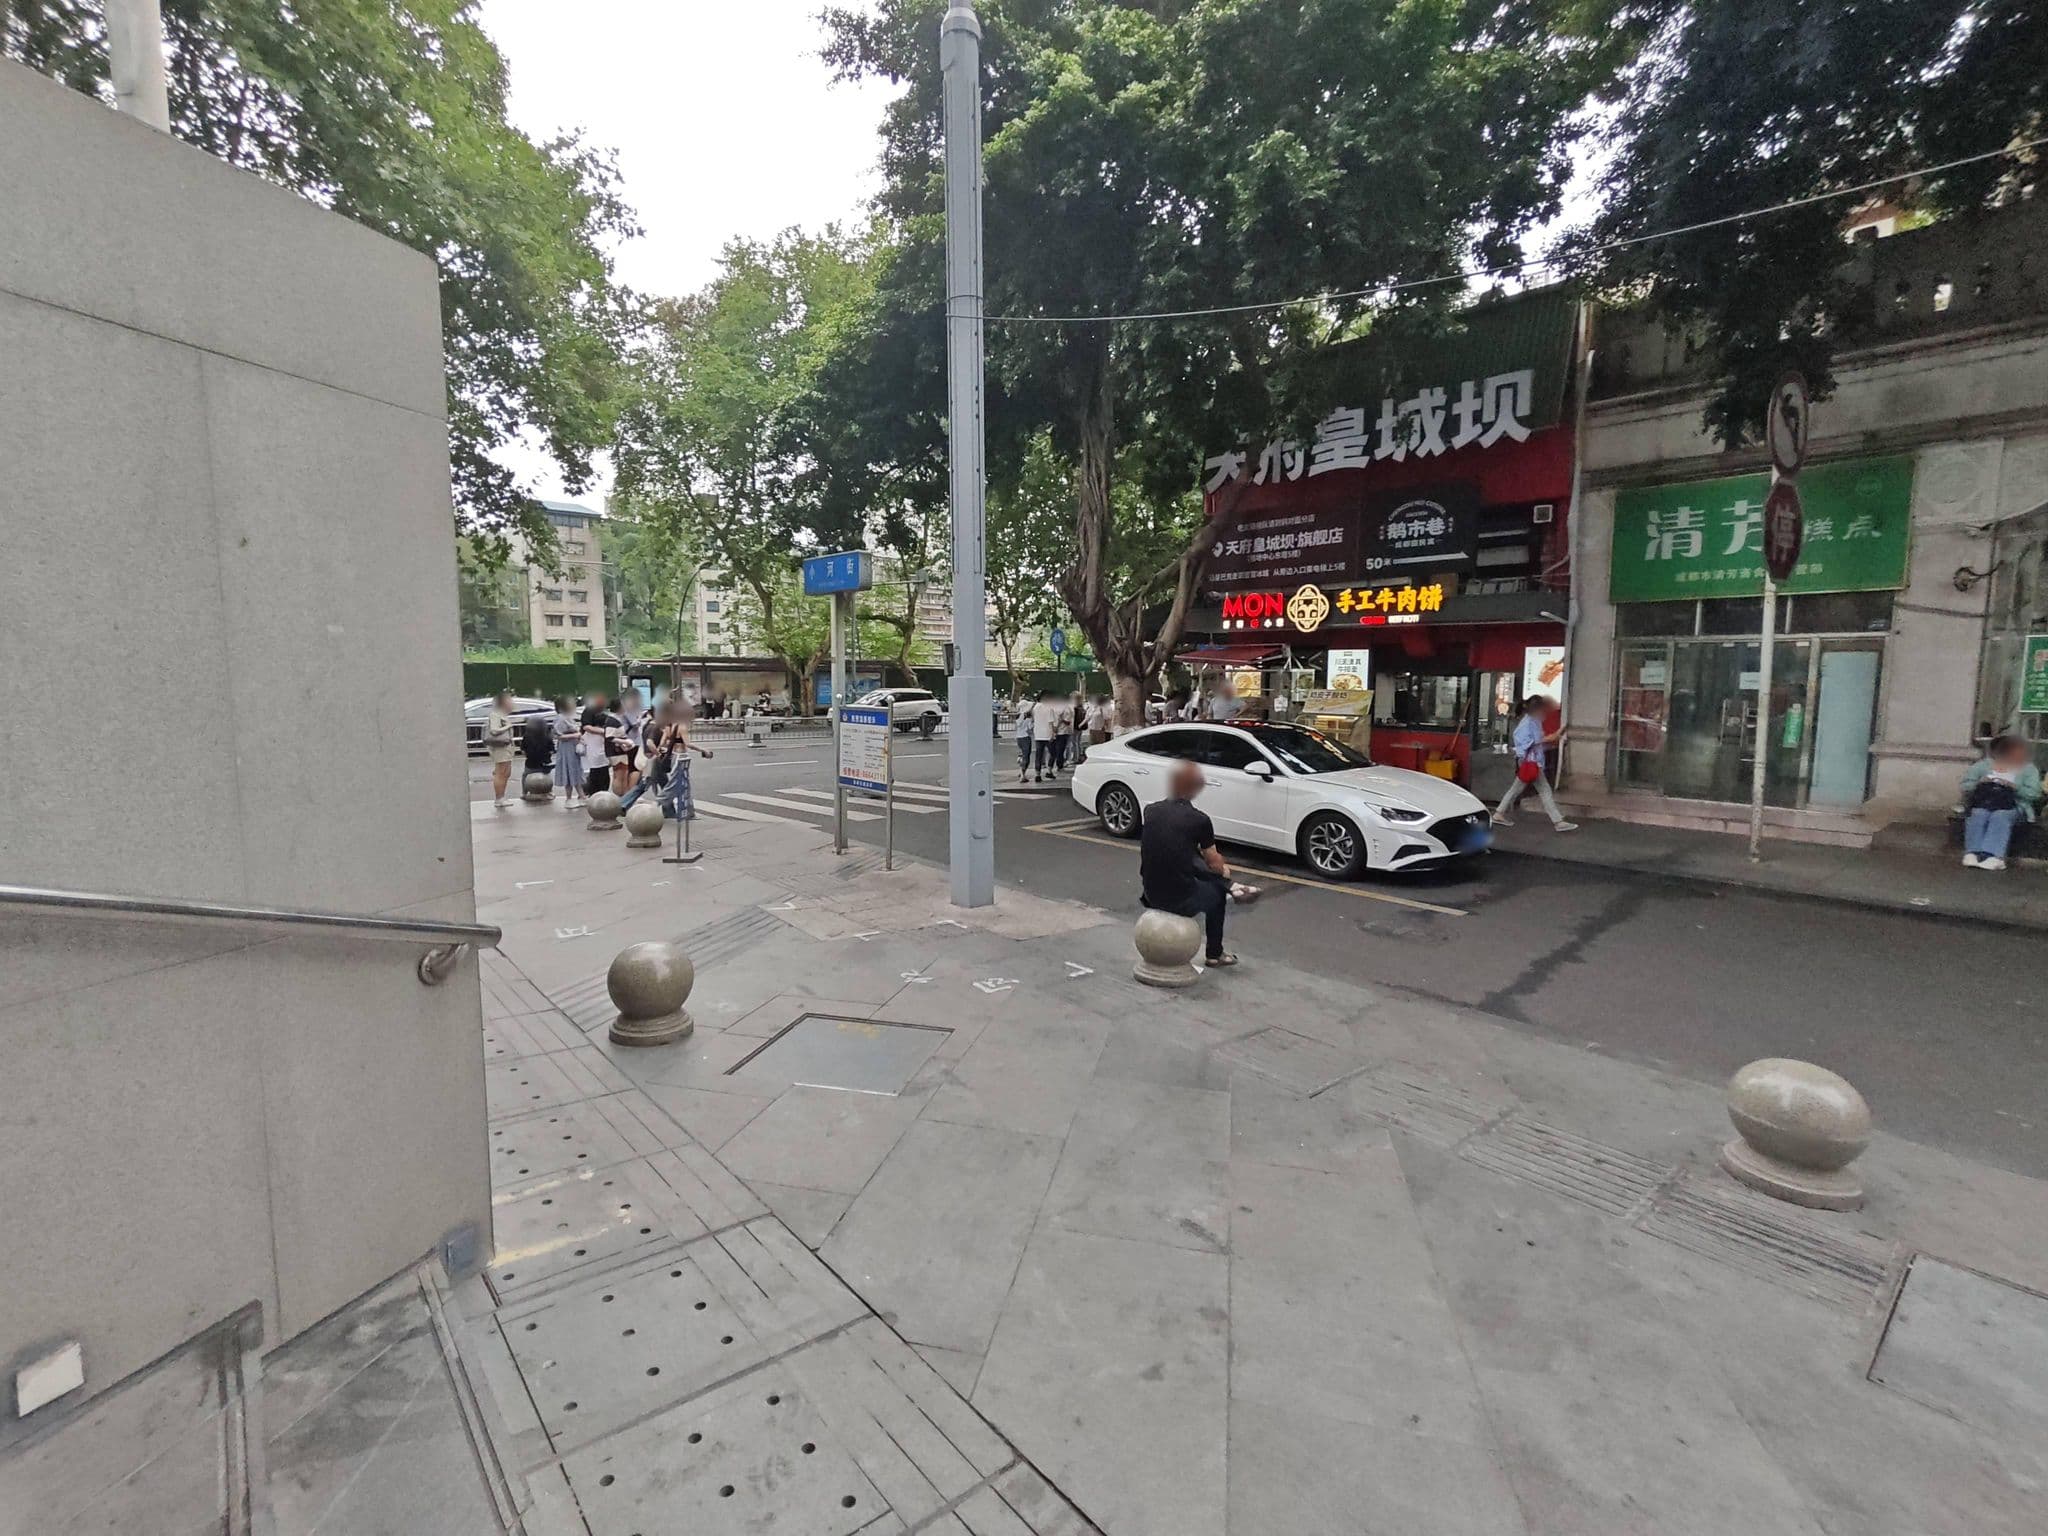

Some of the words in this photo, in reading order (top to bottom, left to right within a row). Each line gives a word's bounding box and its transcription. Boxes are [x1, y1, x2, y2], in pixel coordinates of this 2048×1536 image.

[1222, 592, 1284, 618] MON
[1336, 584, 1443, 614] 手工牛肉饼
